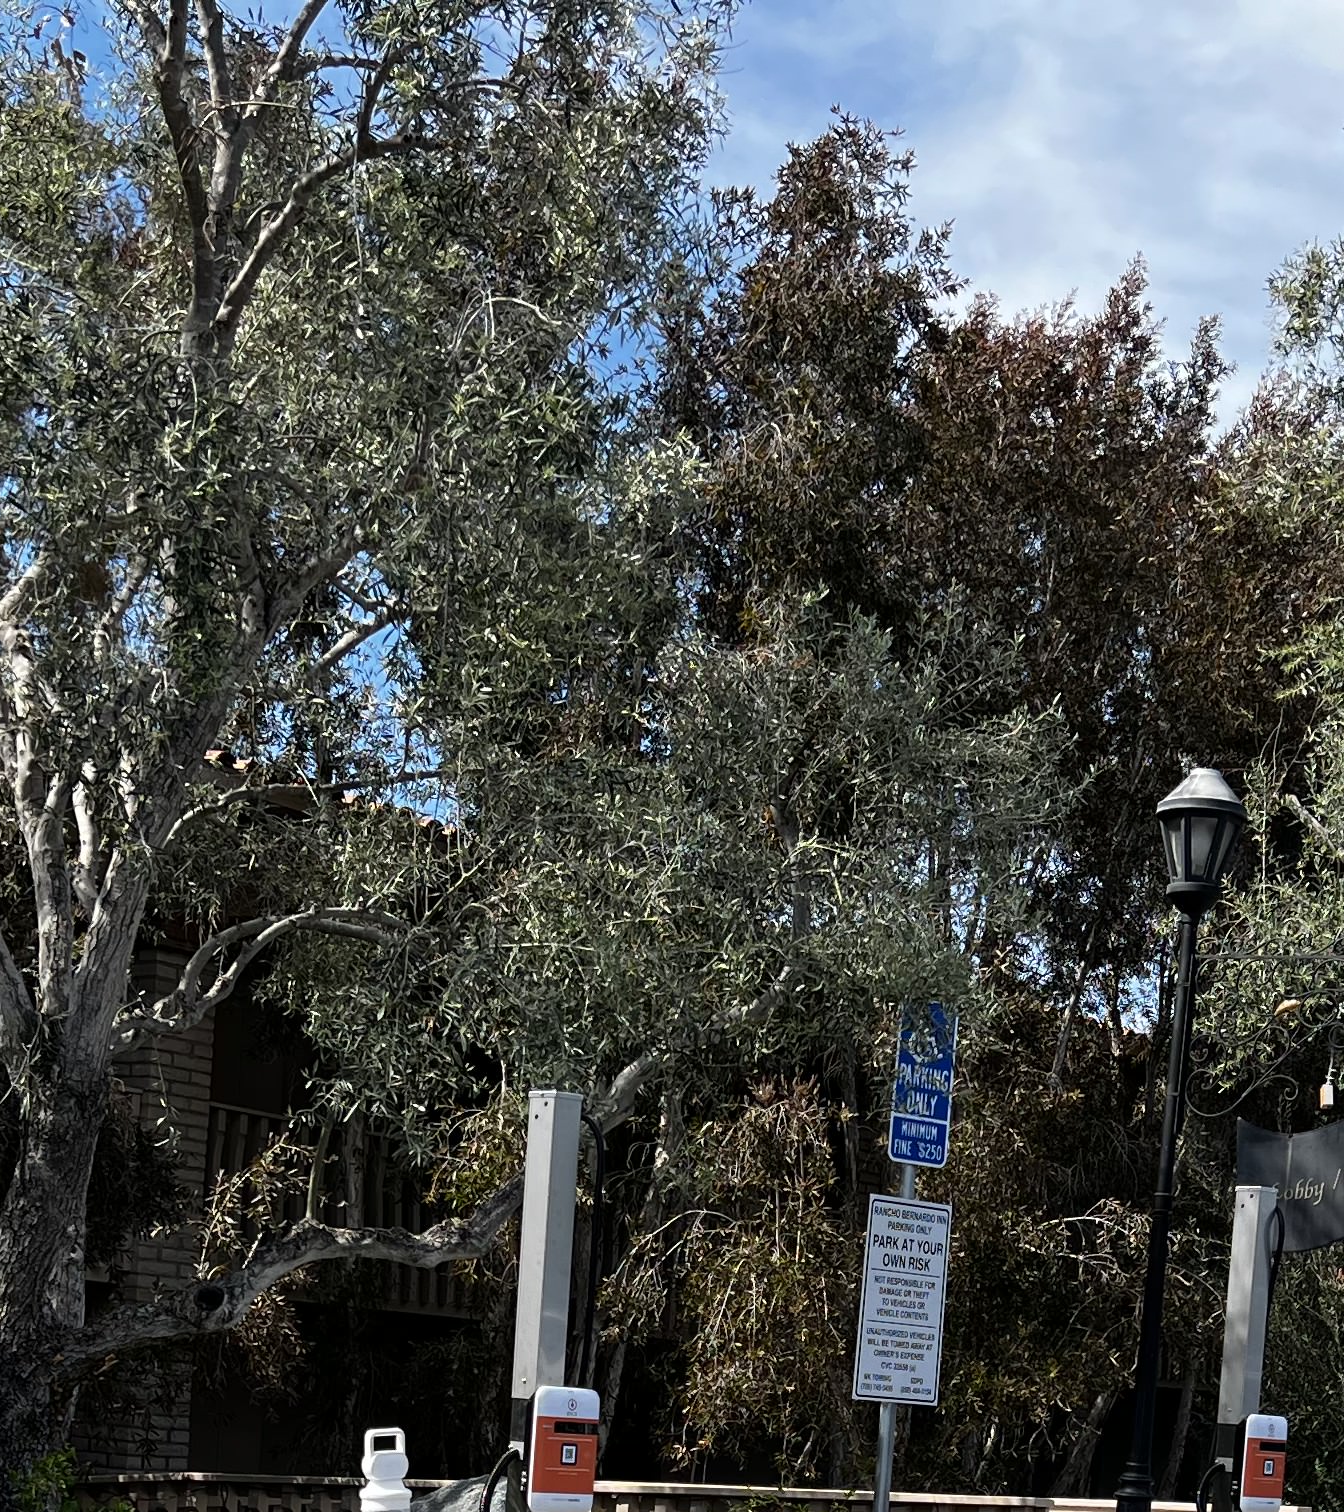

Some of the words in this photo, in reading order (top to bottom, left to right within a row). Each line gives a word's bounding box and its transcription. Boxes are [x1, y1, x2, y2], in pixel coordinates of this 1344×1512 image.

[899, 1062, 949, 1092] PARKING
[907, 1090, 938, 1116] ONLY
[901, 1121, 938, 1141] MINIMUM
[894, 1139, 912, 1156] FINE
[917, 1142, 942, 1160] $250
[874, 1206, 900, 1218] RANCHO
[902, 1210, 935, 1223] BERNARDO
[888, 1221, 914, 1233] PARKING
[916, 1225, 932, 1235] ONLY
[873, 1234, 899, 1250] PARK
[902, 1239, 915, 1252] AT
[917, 1240, 944, 1256] YOUR
[883, 1253, 906, 1268] OWN
[908, 1257, 931, 1272] RISK
[887, 1277, 923, 1288] RESPONSIBLE
[925, 1282, 936, 1290] FOR
[882, 1298, 889, 1306] TO
[890, 1299, 916, 1308] VEHICLES
[913, 1291, 929, 1299] THEFT
[876, 1308, 900, 1318] VEHICLE
